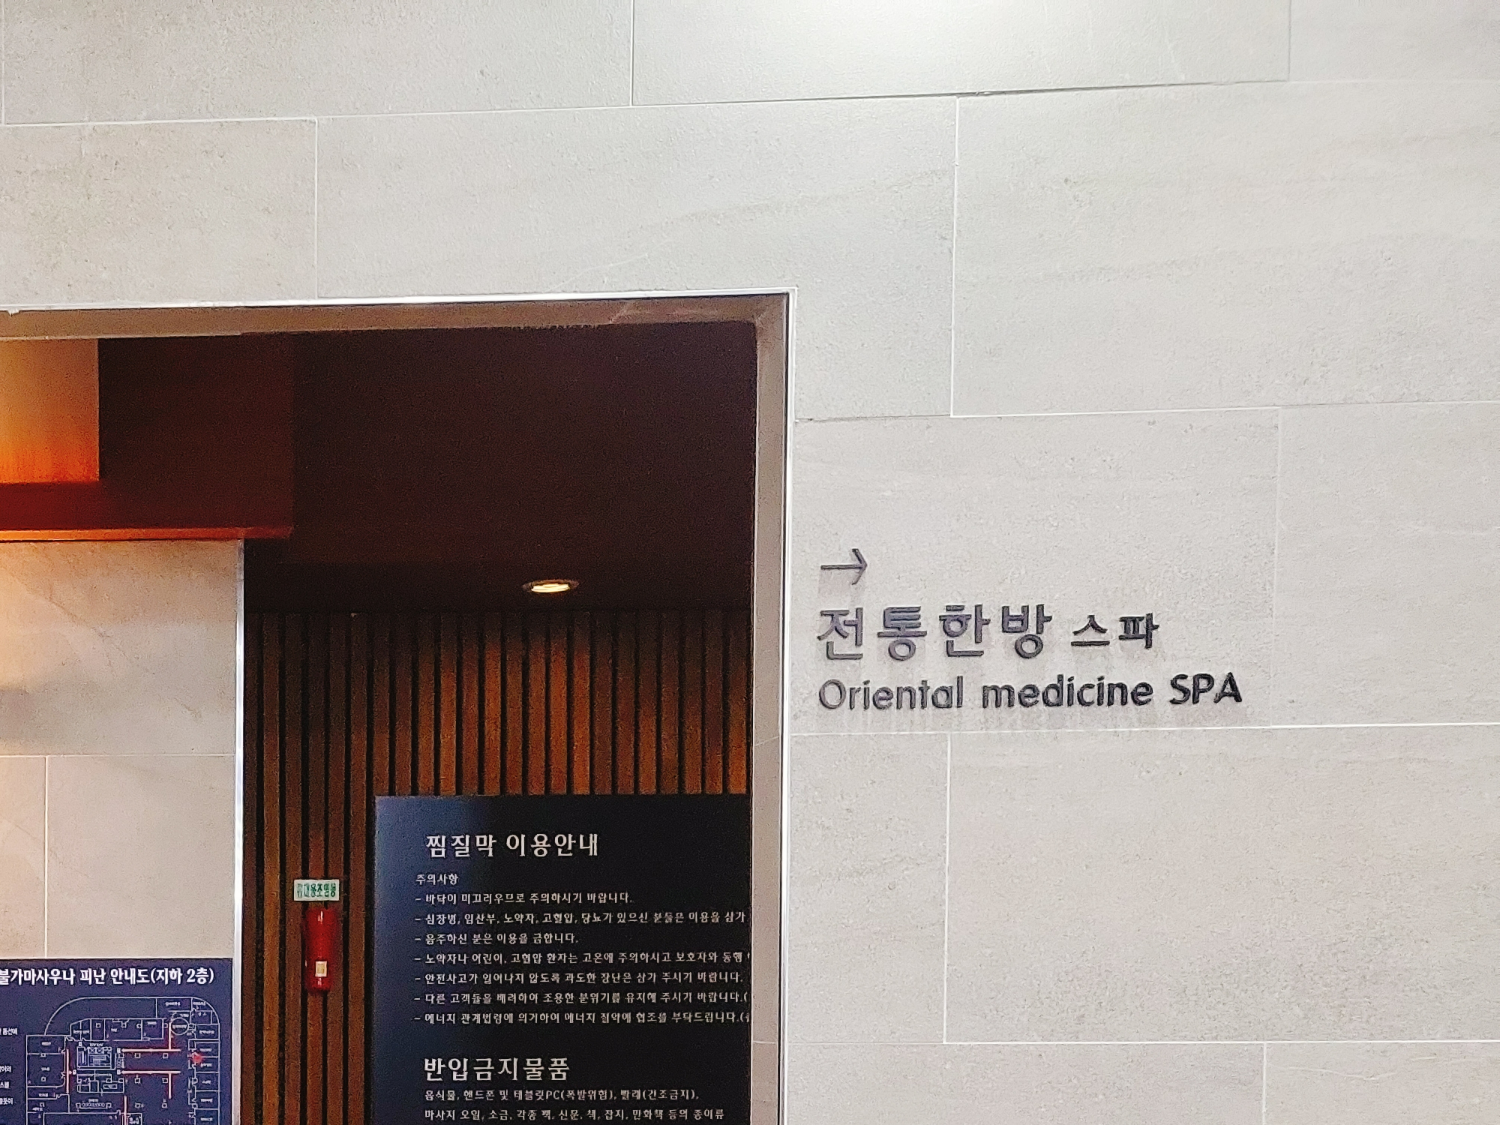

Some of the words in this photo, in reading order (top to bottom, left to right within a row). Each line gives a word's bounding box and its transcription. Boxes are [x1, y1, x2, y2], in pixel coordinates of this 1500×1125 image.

[817, 605, 1052, 661] 전통한방
[1070, 612, 1160, 650] 스파
[818, 675, 964, 711] Oriental
[982, 672, 1155, 708] medicine
[1169, 672, 1243, 705] SPA
[426, 833, 497, 858] 찜질막
[505, 833, 599, 858] 이용안내
[415, 873, 459, 886] 주의사항
[425, 892, 457, 904] 바닥이
[461, 892, 526, 904] 미끄러우므로
[529, 892, 582, 904] 주의하시기
[586, 892, 633, 904] 바랍니다.
[425, 933, 467, 945] 음주하신
[472, 933, 493, 945] 분은
[496, 933, 528, 945] 이용을
[533, 933, 579, 945] 금합니다.
[79, 968, 106, 986] 피난
[111, 968, 183, 986] 안내도(지하
[186, 968, 214, 986] 2층)
[424, 1057, 570, 1081] 반입금지물품
